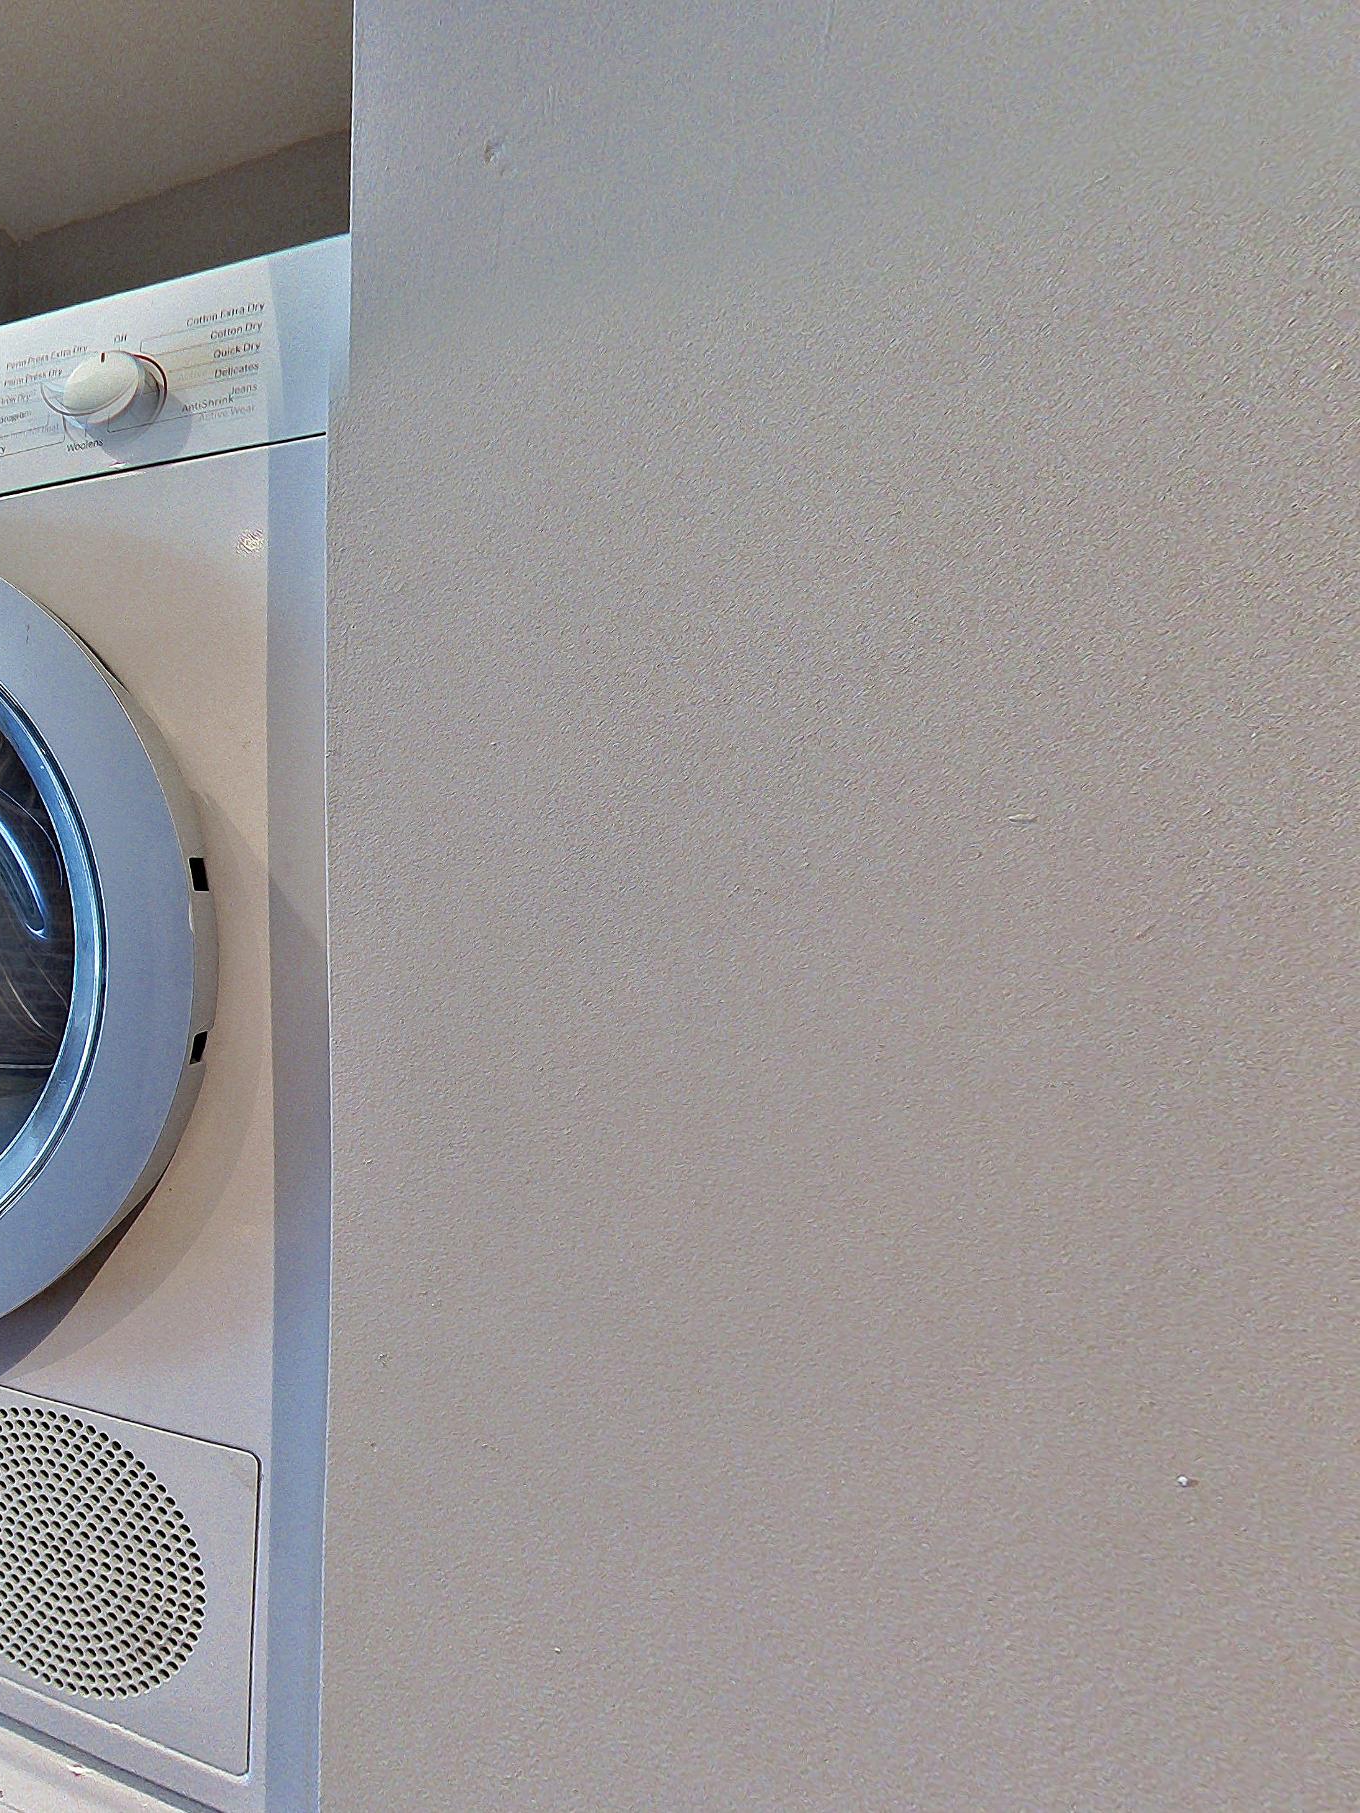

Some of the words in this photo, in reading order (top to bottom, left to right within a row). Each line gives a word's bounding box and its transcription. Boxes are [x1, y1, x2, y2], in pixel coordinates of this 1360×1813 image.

[186, 313, 218, 328] Cotton
[220, 307, 245, 320] Extra
[247, 302, 265, 314] Dry
[210, 326, 242, 340] Cotton
[245, 321, 263, 333] Dry
[72, 345, 89, 356] Dry
[213, 347, 241, 360] Quick
[243, 341, 261, 353] Dry
[214, 363, 259, 379] Delicates
[231, 384, 258, 396] Jeans
[182, 393, 234, 413] AntiShrink
[66, 437, 104, 452] Woolens
